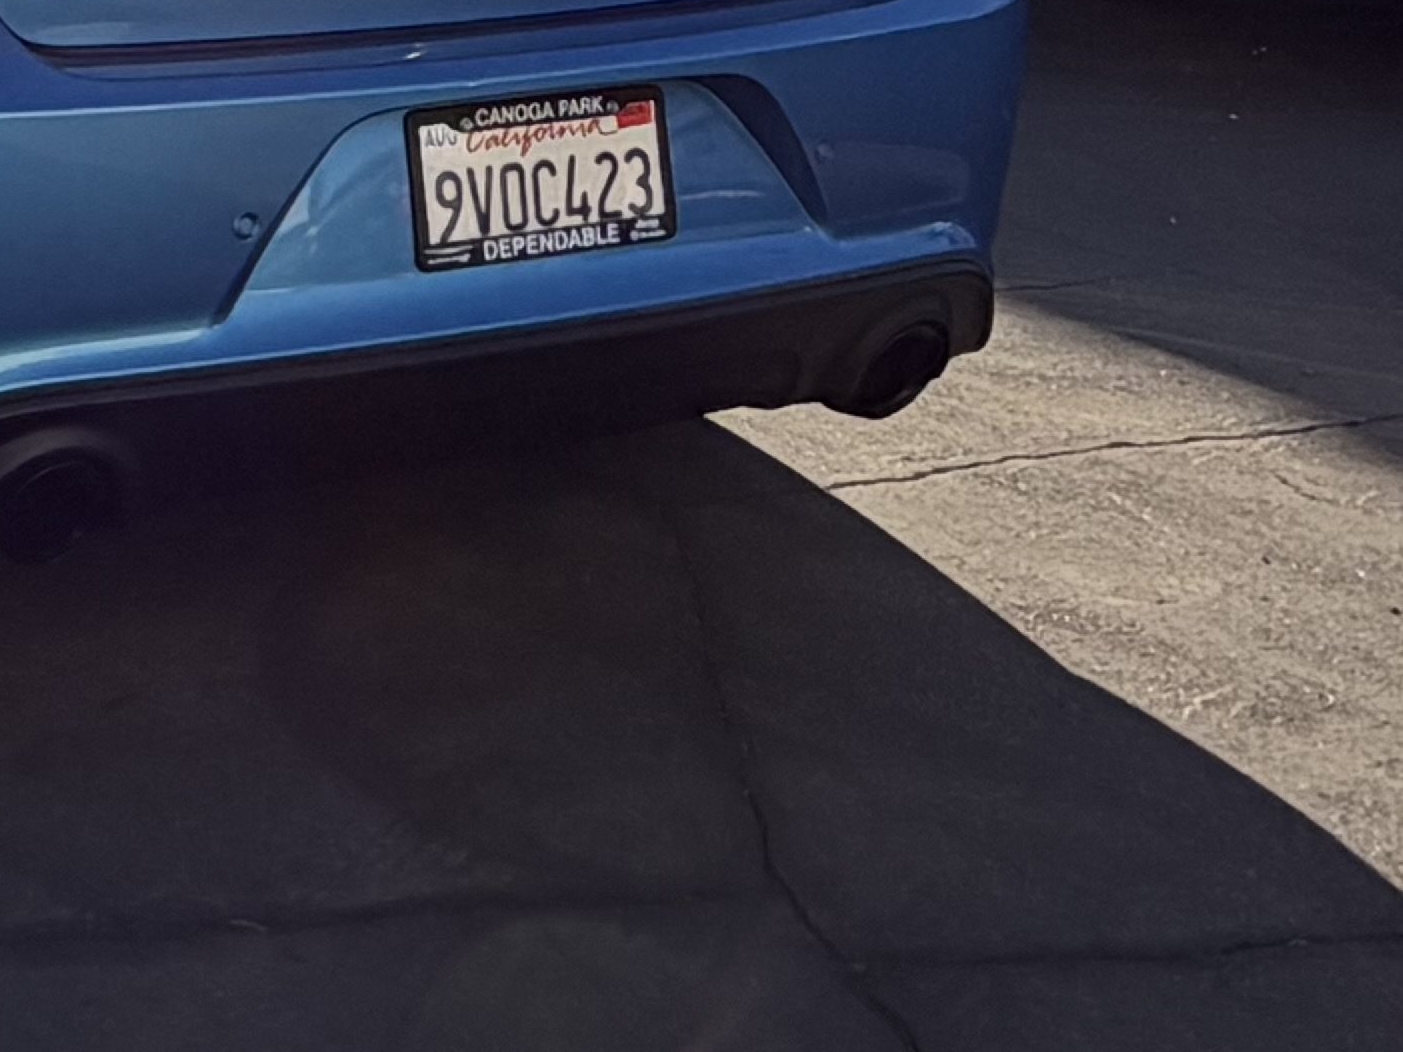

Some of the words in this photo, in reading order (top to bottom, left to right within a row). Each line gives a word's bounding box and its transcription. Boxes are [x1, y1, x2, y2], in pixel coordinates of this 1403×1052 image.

[474, 100, 555, 128] CANOGA
[558, 95, 605, 118] PARK
[465, 117, 617, 158] California
[483, 223, 622, 261] DEPENDABLE
